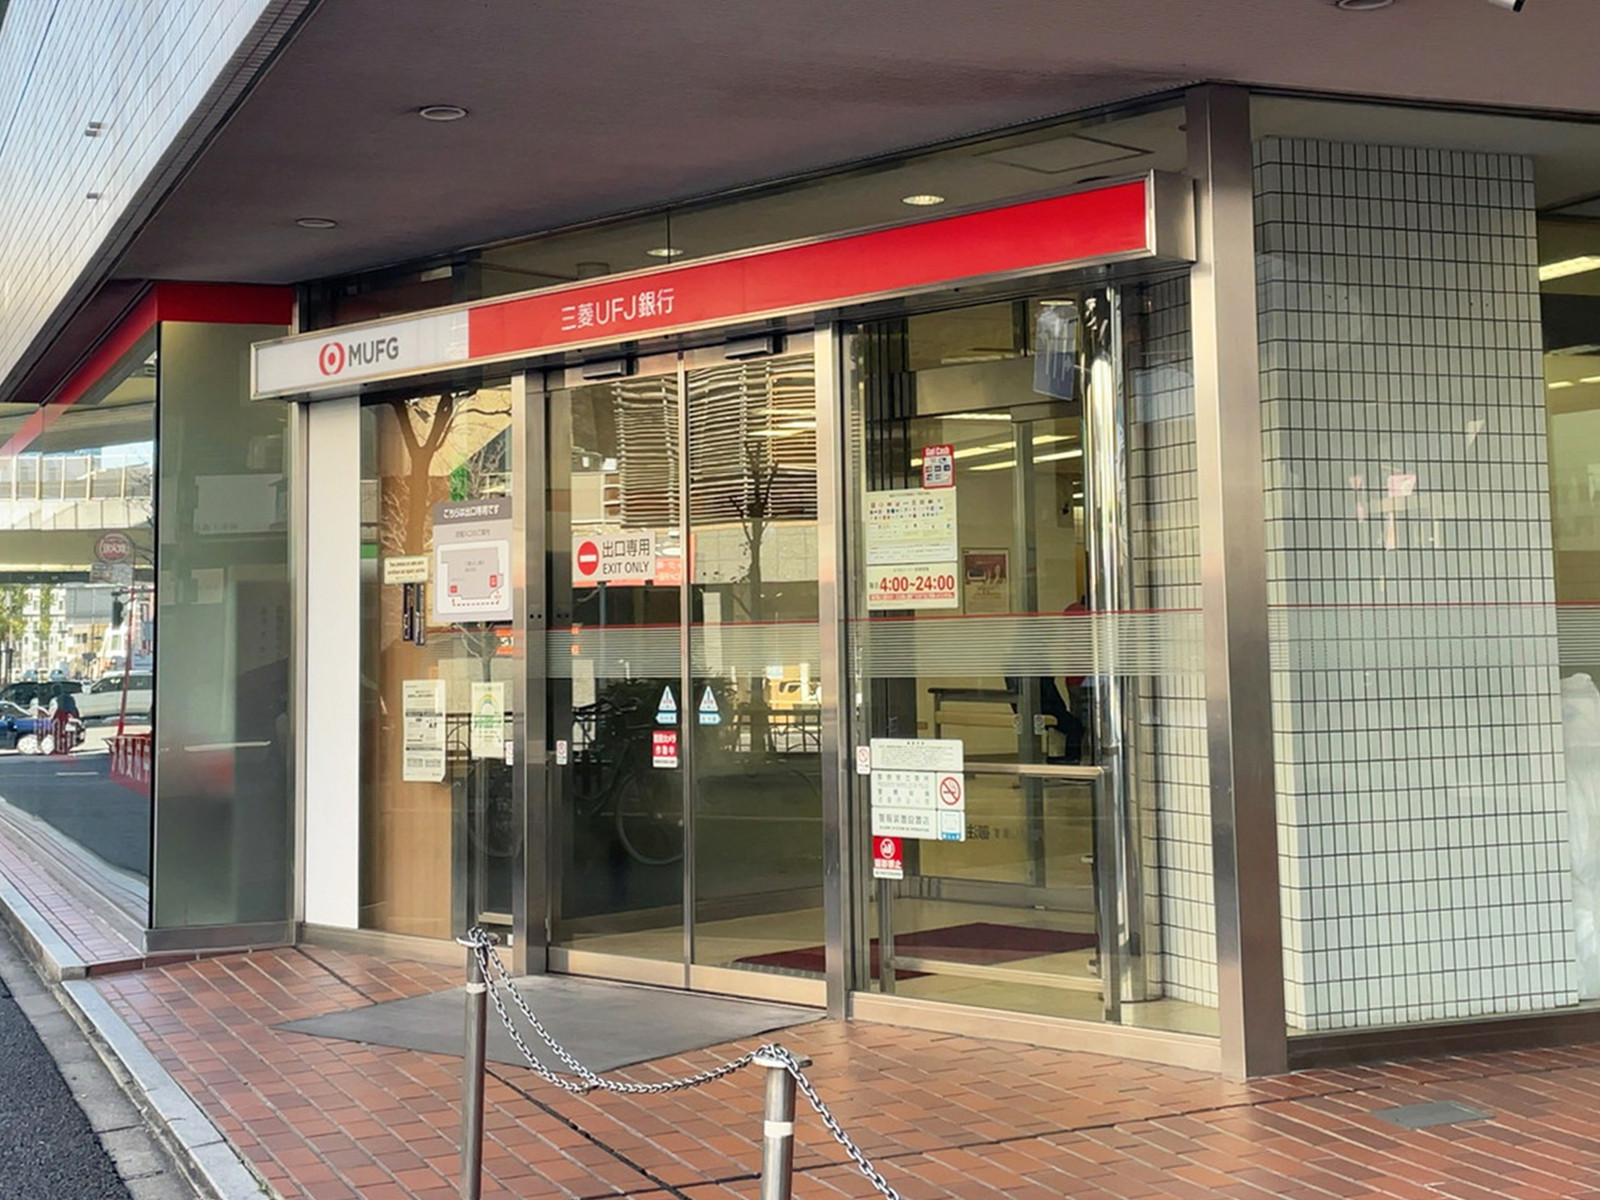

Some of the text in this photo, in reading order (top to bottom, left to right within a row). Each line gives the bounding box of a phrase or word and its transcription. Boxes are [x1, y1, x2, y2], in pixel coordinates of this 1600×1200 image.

[560, 287, 675, 331] 三菱UFJ銀行
[348, 336, 399, 367] MUFG
[602, 538, 650, 558] 出口専用
[603, 562, 622, 575] EXIT
[624, 561, 649, 574] ONLY
